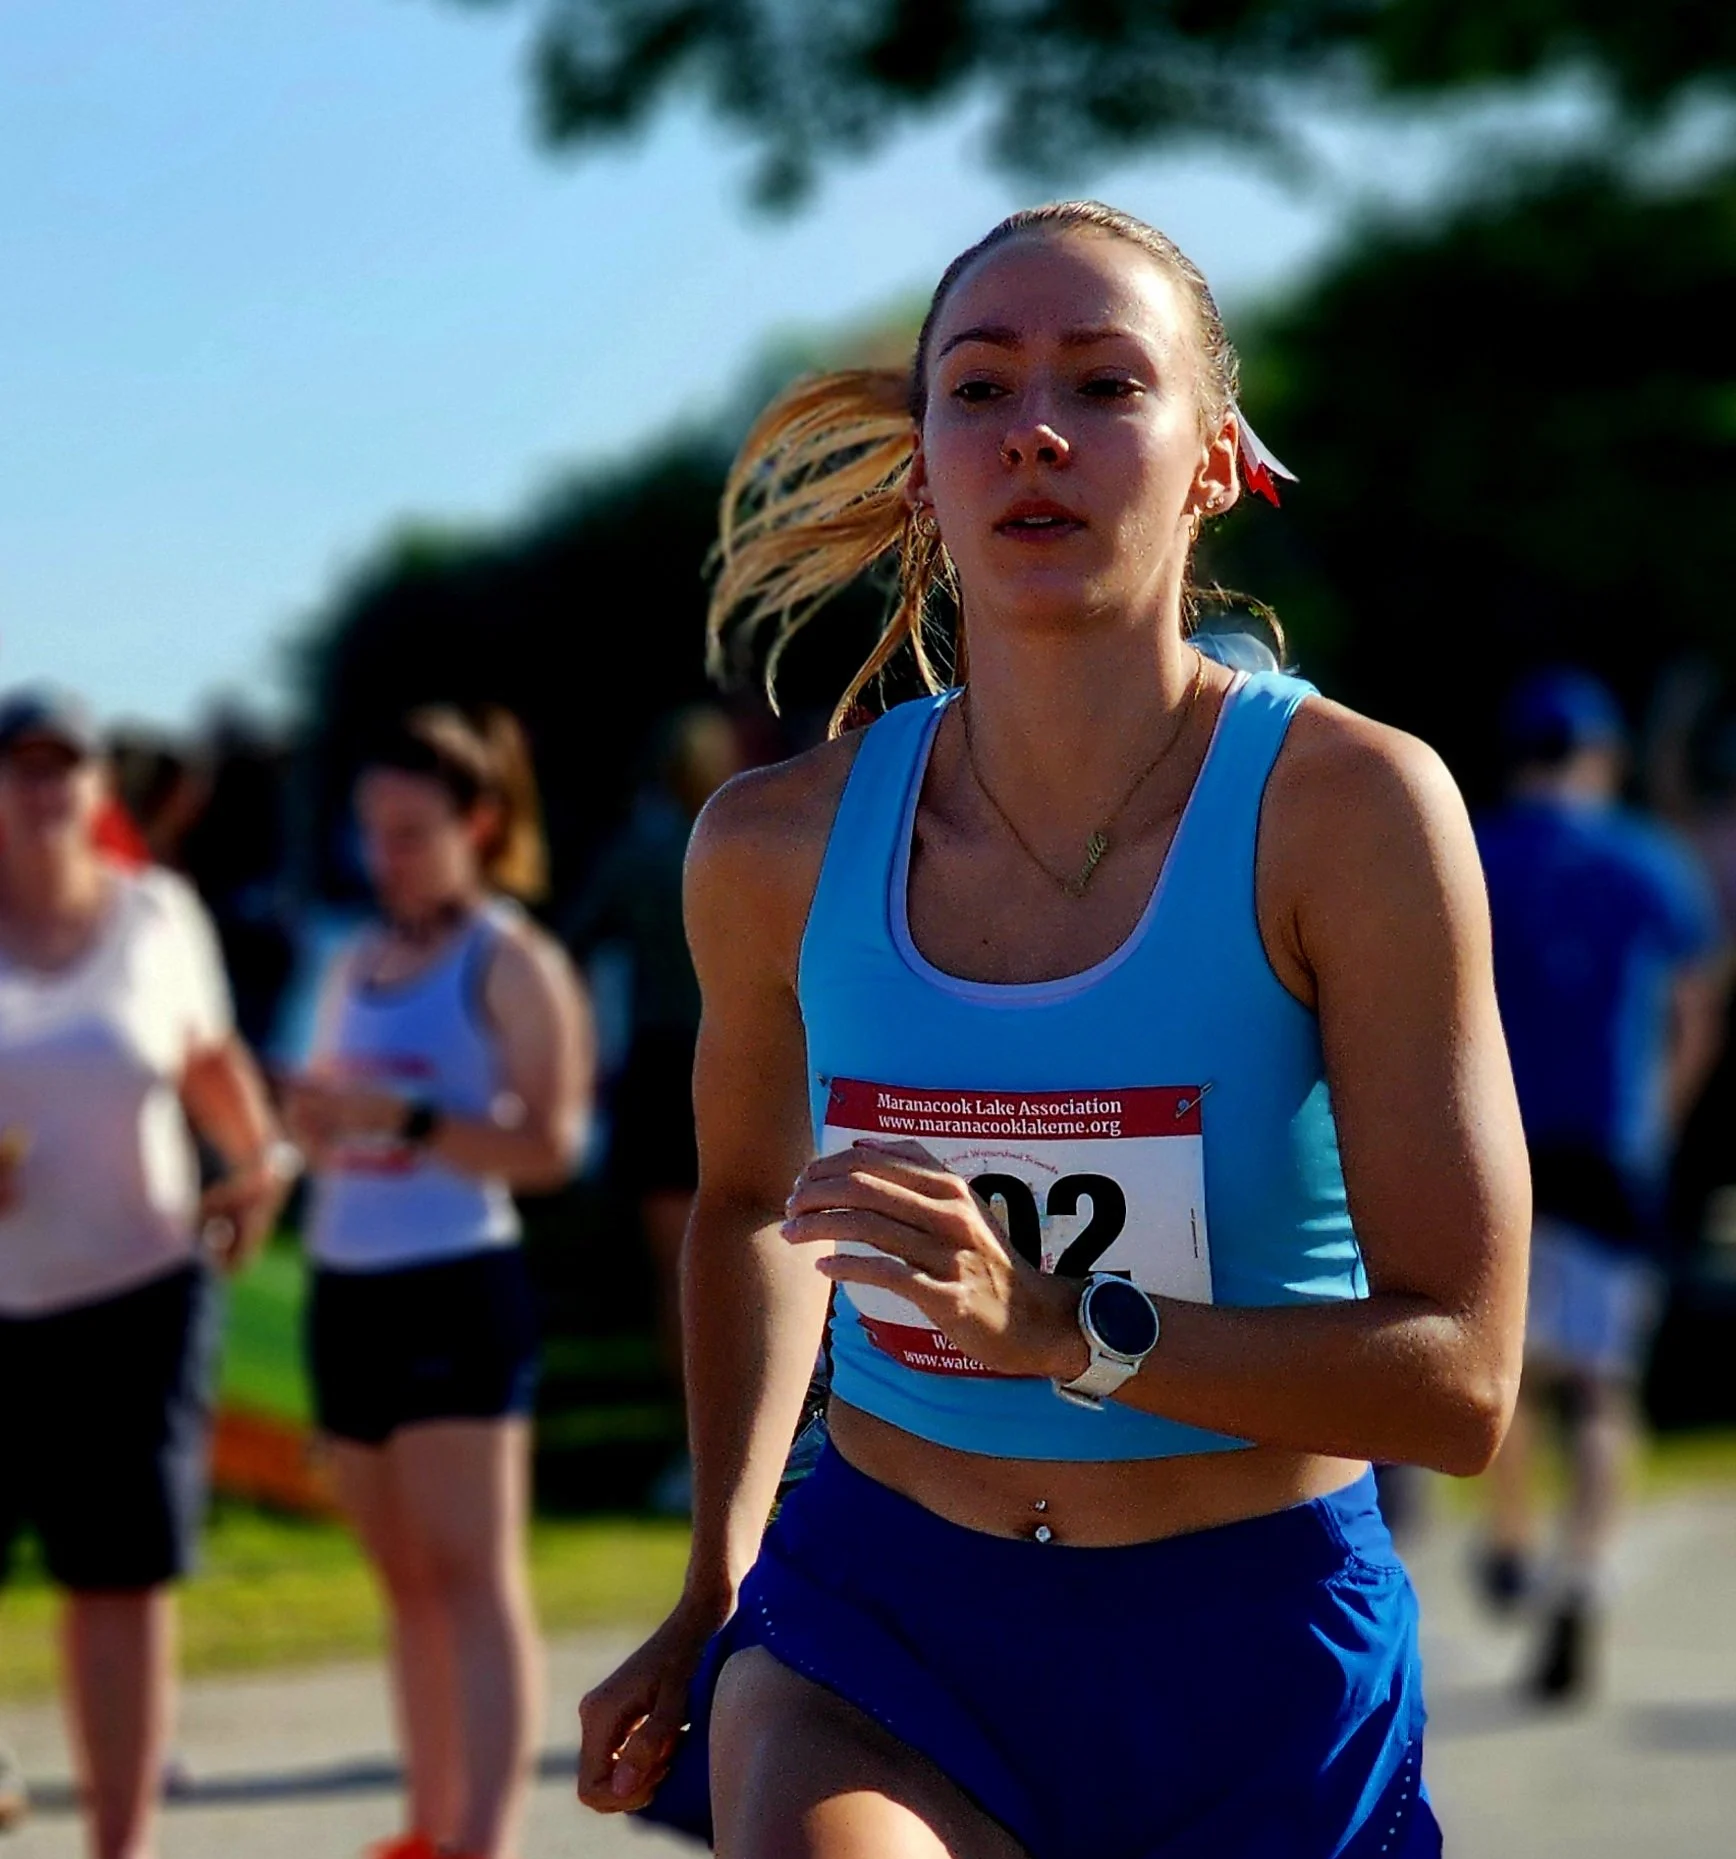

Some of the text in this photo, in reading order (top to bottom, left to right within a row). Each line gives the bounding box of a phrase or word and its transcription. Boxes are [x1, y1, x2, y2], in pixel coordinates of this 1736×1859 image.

[876, 1092, 1122, 1116] Maranacook Lake Association
[878, 1114, 1122, 1136] www.maranacooklakeme.org
[931, 1333, 958, 1351] Wa
[903, 1350, 992, 1371] www.water
